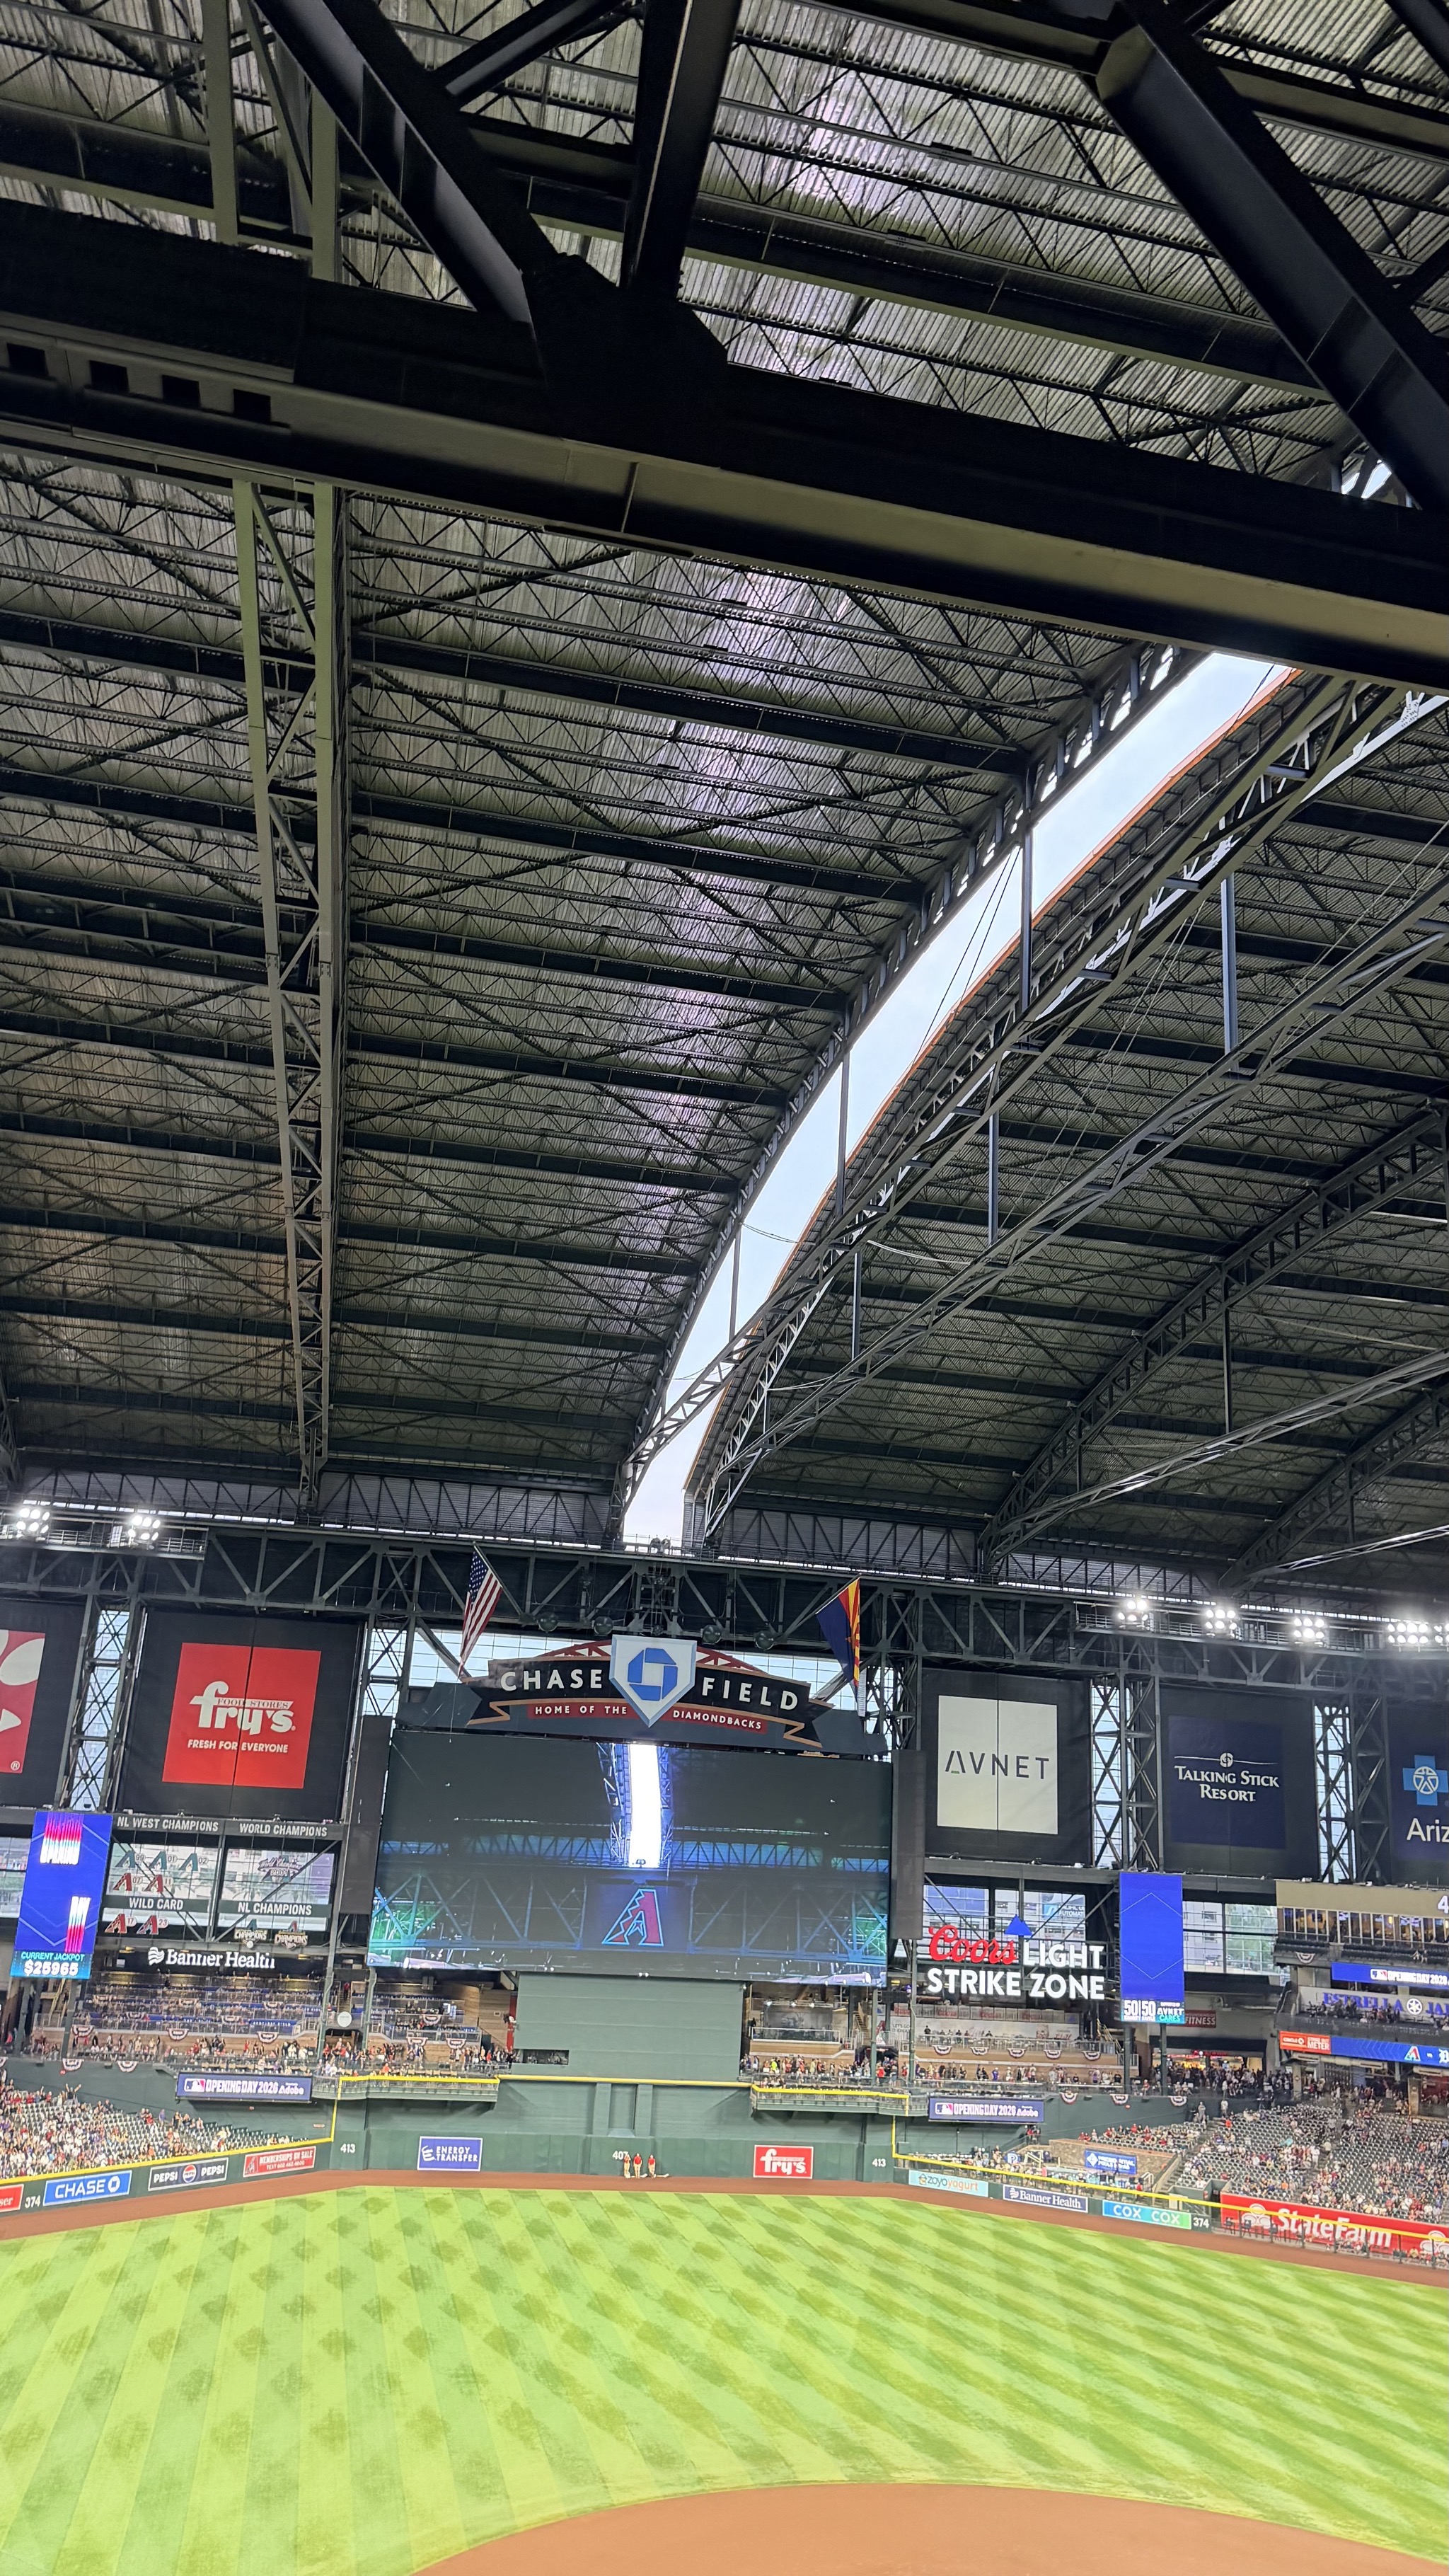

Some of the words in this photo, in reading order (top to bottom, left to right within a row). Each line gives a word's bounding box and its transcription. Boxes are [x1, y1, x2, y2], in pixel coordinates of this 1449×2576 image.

[500, 1669, 602, 1691] CHASE
[702, 1677, 798, 1710] FIELD
[189, 1681, 294, 1735] fry's
[217, 1698, 246, 1708] FOOD
[250, 1699, 289, 1710] STORES
[535, 1706, 570, 1715] HOME
[579, 1706, 594, 1714] OF
[605, 1706, 627, 1715] THE
[673, 1710, 761, 1730] DIAMONDBACKS
[187, 1739, 217, 1749] FRESH
[219, 1740, 238, 1750] FOR
[241, 1742, 289, 1754] EVERYONE
[945, 1750, 1050, 1779] AVNET
[1174, 1765, 1237, 1784] TALKING
[1240, 1770, 1280, 1788] STICK
[1199, 1783, 1257, 1802] RESORT
[117, 1817, 129, 1827] NL
[132, 1818, 161, 1829] WEST
[162, 1819, 219, 1832] CHAMPIONS
[239, 1823, 271, 1834] WORLD
[273, 1826, 328, 1837] CHAMPIONS
[129, 1897, 154, 1909] WILD
[156, 1899, 184, 1910] CARD
[238, 1902, 250, 1910] NL
[253, 1903, 312, 1916] CHAMPIONS
[928, 1924, 1017, 1965] Coors
[1023, 1940, 1104, 1969] LIGHT
[21, 1951, 54, 1960] CURRENT
[54, 1953, 85, 1962] JACKPOT
[165, 1948, 224, 1967] Banner
[23, 1958, 79, 1977] $25965
[1387, 1970, 1416, 1983] OPENING
[928, 1968, 1021, 1996] STRIKE
[1029, 1974, 1105, 2000] ZONE
[1185, 2016, 1216, 2025] FITNESS
[1307, 2041, 1330, 2051] METER
[206, 2079, 241, 2093] OPENING
[241, 2081, 258, 2093] DAY
[258, 2081, 279, 2094] 2026
[278, 2085, 304, 2095] Adobe
[954, 2103, 985, 2115] OPENING
[984, 2104, 999, 2116] DAY
[998, 2105, 1017, 2116] 2026
[1016, 2108, 1039, 2117] Adobe
[340, 2143, 356, 2154] 413
[436, 2146, 471, 2154] ENERGY
[259, 2152, 293, 2164] MEMBERSHIPS
[301, 2149, 313, 2158] SALE
[436, 2154, 478, 2163] TRANSFER
[760, 2148, 807, 2175] fry's
[872, 2158, 887, 2168] 413
[153, 2171, 178, 2183] PEPSI
[201, 2164, 224, 2177] PEPSI
[54, 2179, 106, 2199] CHASE
[24, 2195, 41, 2209] 374
[1020, 2190, 1051, 2204] Banner
[1052, 2195, 1081, 2209] Health
[1113, 2204, 1141, 2219] COX
[1151, 2210, 1180, 2225] COX
[1193, 2216, 1210, 2229] 374
